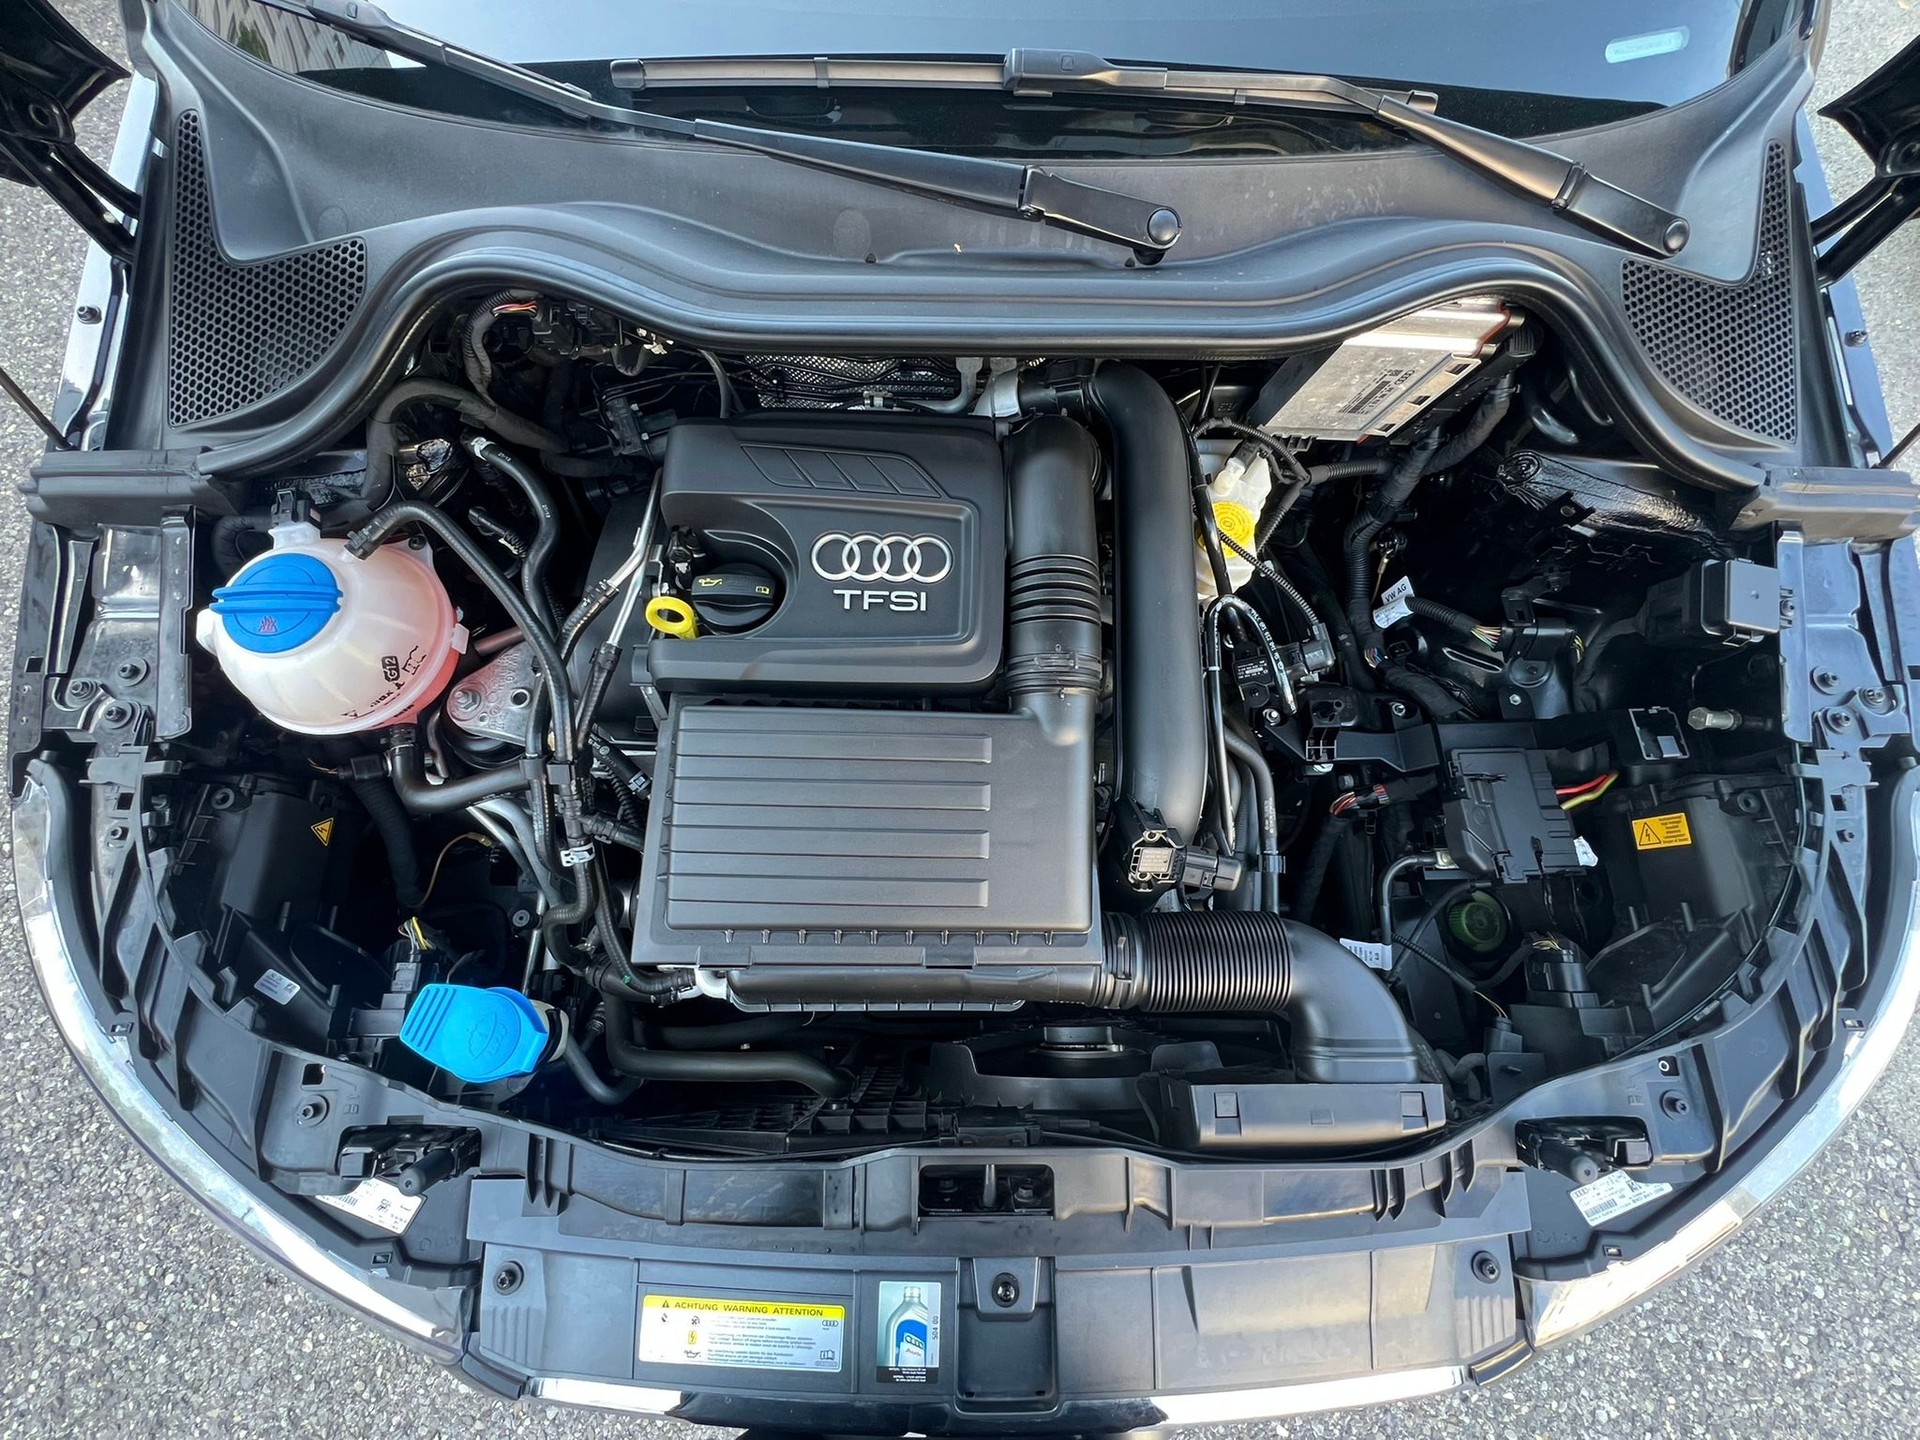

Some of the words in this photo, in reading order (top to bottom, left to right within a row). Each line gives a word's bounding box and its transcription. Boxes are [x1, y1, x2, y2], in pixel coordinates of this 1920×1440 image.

[834, 589, 926, 611] TFSI
[1385, 590, 1396, 602] VW
[1397, 583, 1407, 594] AG
[385, 657, 397, 680] G12
[674, 1301, 719, 1312] ACHTUNG
[723, 1304, 769, 1314] WARNING
[772, 1307, 823, 1317] ATTENTION
